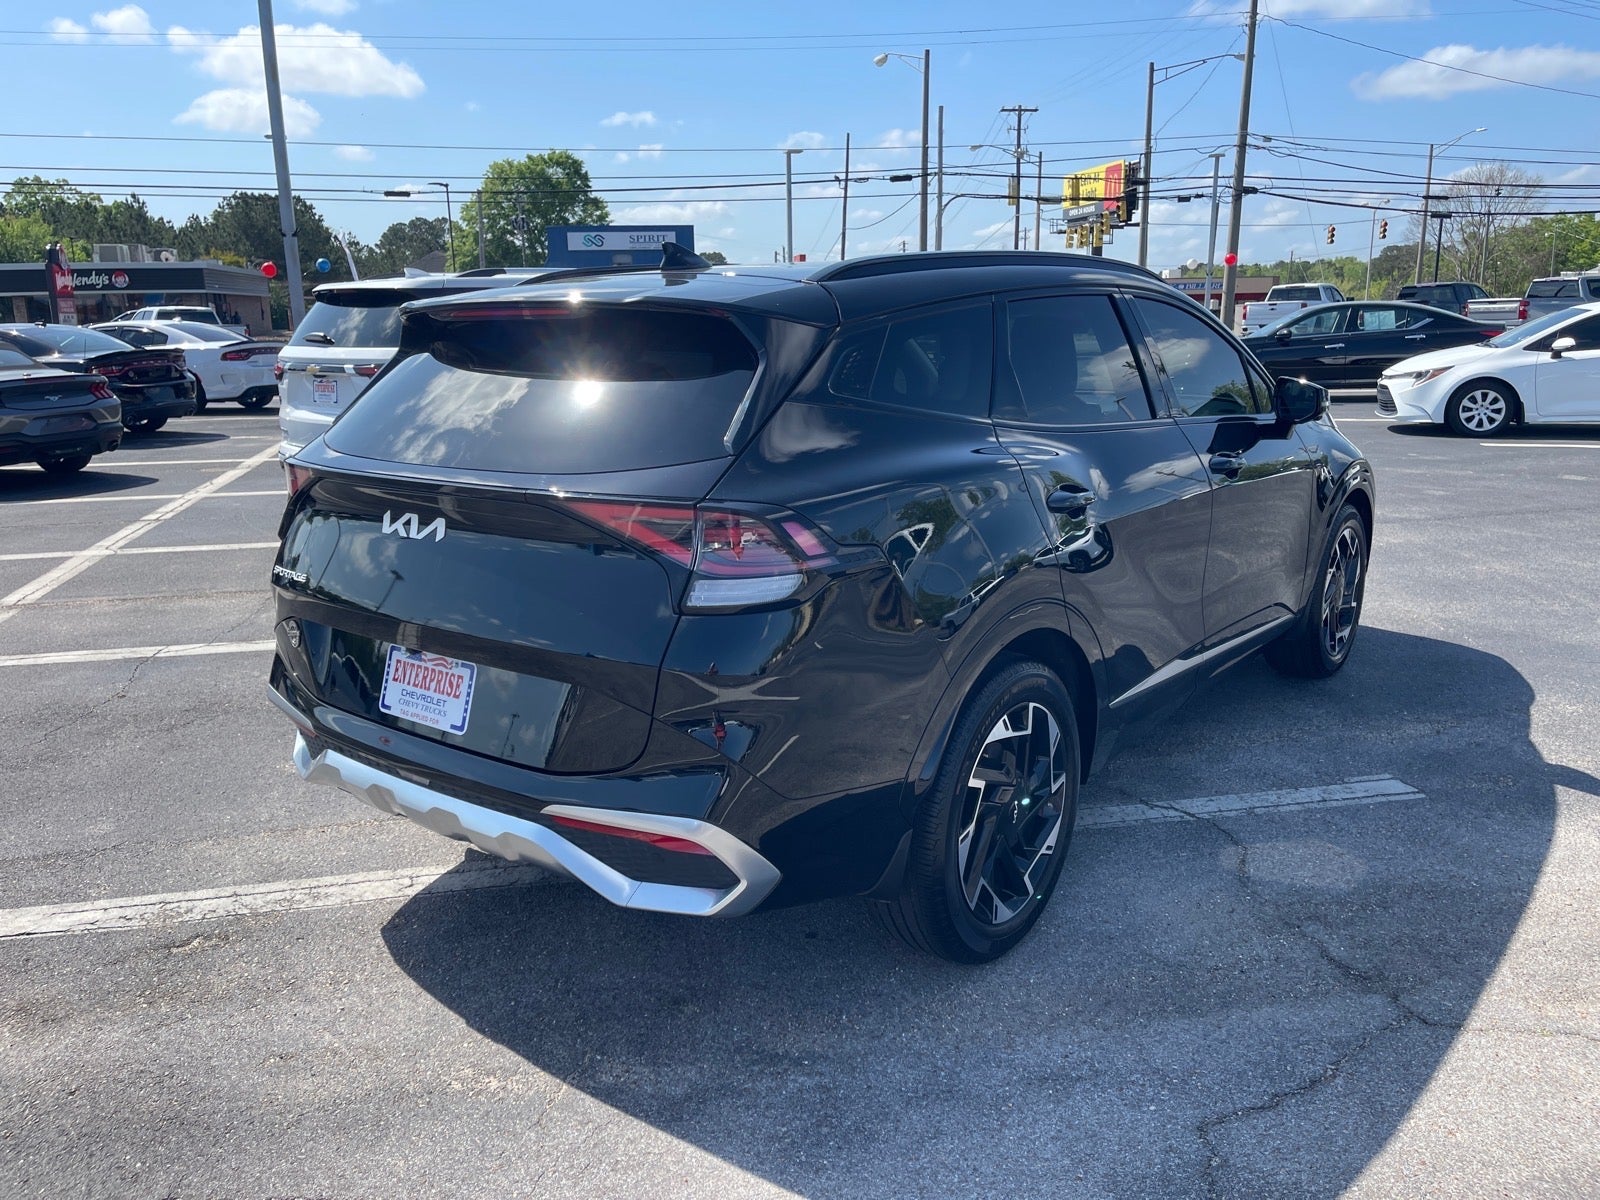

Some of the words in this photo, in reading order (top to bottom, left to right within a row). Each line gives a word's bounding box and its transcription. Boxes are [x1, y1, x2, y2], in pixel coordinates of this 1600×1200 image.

[629, 234, 668, 243] SPIRIT
[382, 510, 446, 542] KIA
[273, 564, 308, 583] SPORTAGE
[392, 658, 464, 699] ENTERPRISE
[401, 688, 447, 707] CHEVROLET
[398, 698, 420, 710] CHEVY
[421, 704, 447, 717] TRUCKS
